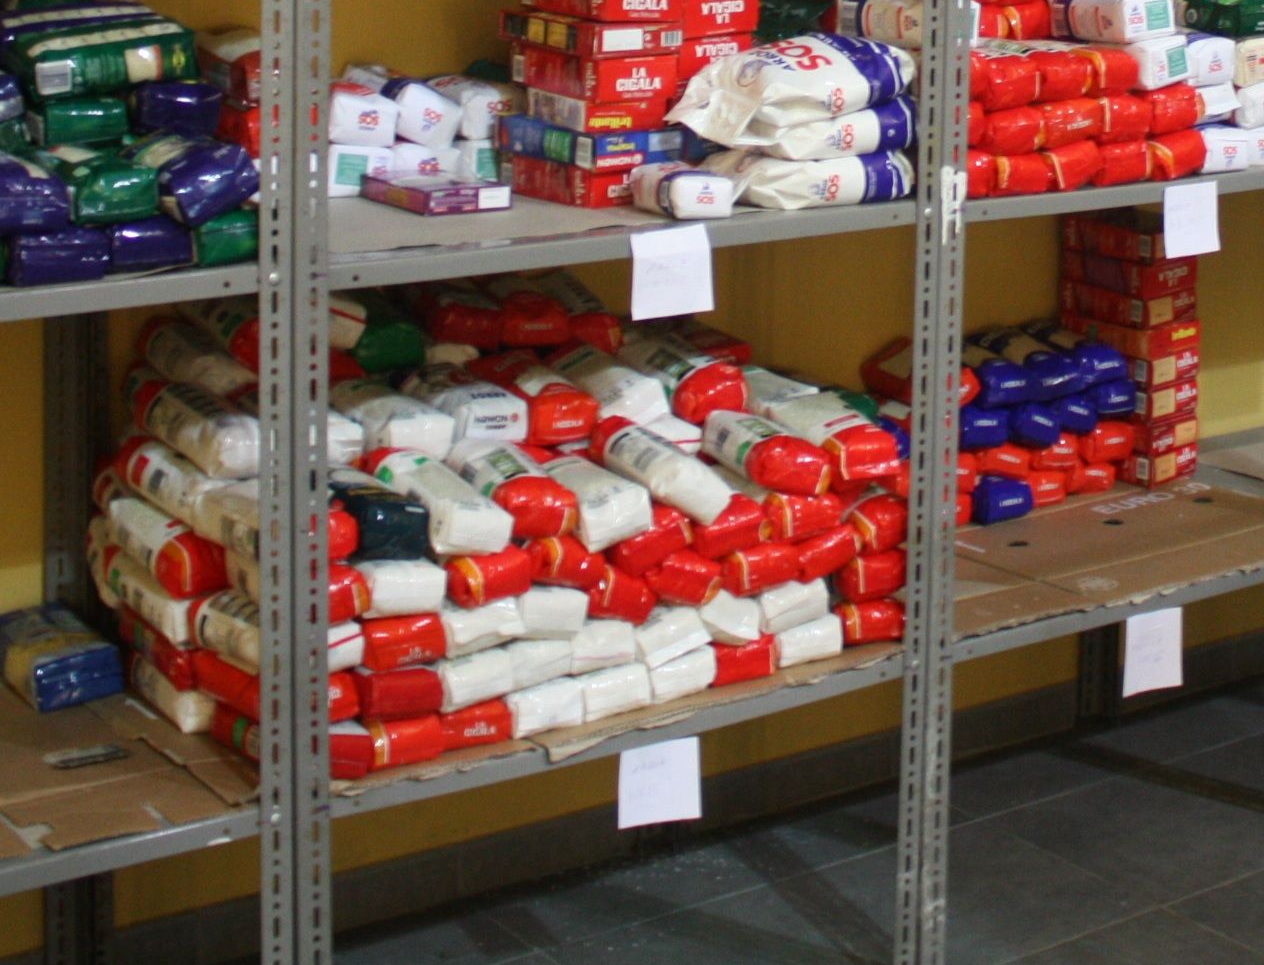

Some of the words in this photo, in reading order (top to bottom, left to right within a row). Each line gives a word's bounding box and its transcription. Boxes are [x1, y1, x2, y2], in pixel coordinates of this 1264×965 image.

[701, 0, 745, 15] CIGALA
[631, 67, 647, 78] LA
[615, 78, 662, 92] CIGALA
